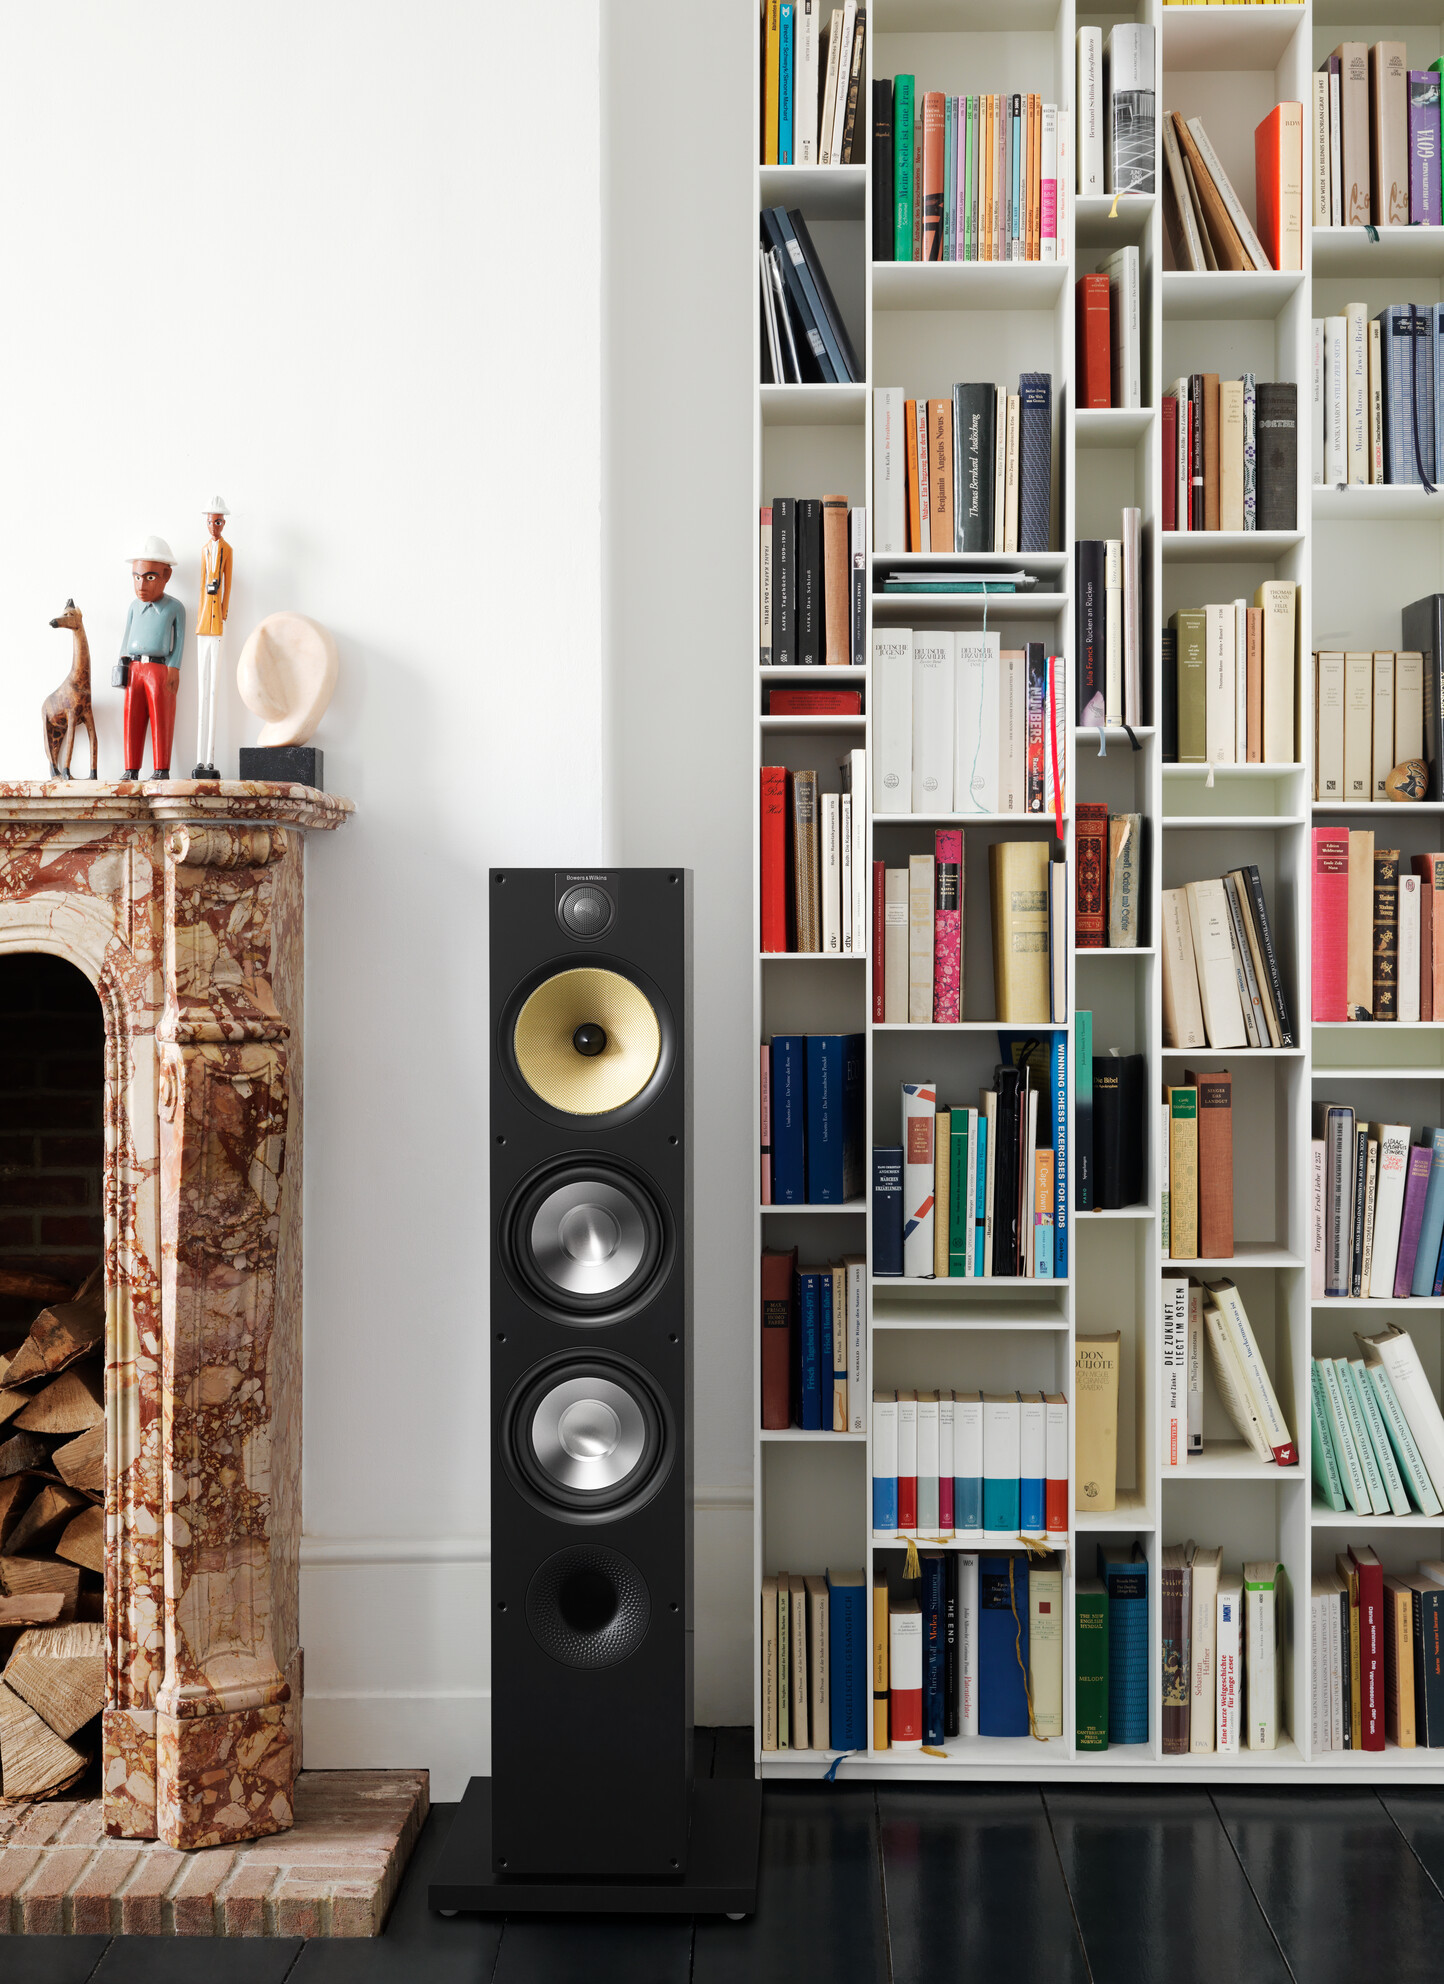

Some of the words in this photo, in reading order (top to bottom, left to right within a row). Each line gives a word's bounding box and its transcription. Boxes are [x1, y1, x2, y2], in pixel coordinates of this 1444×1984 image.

[782, 24, 790, 43] Brecht
[898, 85, 909, 105] Frau
[782, 96, 790, 121] Machard
[900, 107, 909, 127] eine
[898, 130, 909, 140] ist
[1416, 129, 1434, 158] GOYA
[898, 143, 909, 168] Seele
[898, 171, 909, 199] Meine
[1354, 317, 1363, 342] Briefe
[1355, 347, 1363, 375] Pawels
[1355, 390, 1363, 417] Maron
[936, 417, 944, 440] Novus
[970, 414, 981, 454] Auslöschung
[1355, 420, 1363, 451] Monika
[936, 442, 946, 472] Angelus
[920, 461, 928, 486] Flugzeug
[969, 458, 979, 490] Bernhard
[938, 478, 947, 513] Benjamin
[969, 491, 979, 518] Thomas
[1085, 582, 1093, 607] Rücken
[1087, 608, 1093, 617] an
[1085, 618, 1093, 643] Rücken
[1030, 687, 1042, 744] NUMBERS
[1236, 968, 1245, 992] FICCIONES
[1058, 1044, 1066, 1088] WINNING
[1058, 1090, 1066, 1124] CHESS
[1058, 1126, 1066, 1179] EXERCISES
[1040, 1168, 1048, 1187] Cape
[1040, 1190, 1048, 1211] Town
[1058, 1183, 1066, 1200] FOR
[1058, 1205, 1066, 1228] KIDS
[806, 1292, 814, 1328] 1966-1971
[1176, 1288, 1184, 1317] OSTEN
[1164, 1304, 1174, 1345] ZUKUNFT
[1176, 1323, 1184, 1334] IM
[806, 1329, 816, 1362] Tagebuch
[1081, 1351, 1104, 1360] DON
[1164, 1349, 1174, 1366] DIE
[1176, 1340, 1184, 1366] LIEGT
[1075, 1360, 1114, 1369] UIJOTE
[807, 1367, 815, 1389] Frisch
[1312, 1386, 1324, 1418] Northanger
[1332, 1389, 1344, 1420] FRIEDEN
[1322, 1432, 1330, 1446] Abtei
[1340, 1421, 1348, 1436] UND
[1280, 1449, 1291, 1460] K
[1344, 1438, 1354, 1460] KRIEG
[1350, 1462, 1362, 1490] TOLSTOJ
[1333, 1483, 1341, 1495] Jane
[929, 1574, 937, 1610] Stimmen
[1223, 1605, 1231, 1622] DUMONT
[845, 1596, 853, 1659] GESANGBUCH
[929, 1615, 938, 1641] Medea
[929, 1645, 937, 1663] Wolf
[929, 1667, 937, 1695] Christa
[845, 1664, 854, 1739] EVANGELISCHES
[964, 1676, 972, 1718] Patentöchter
